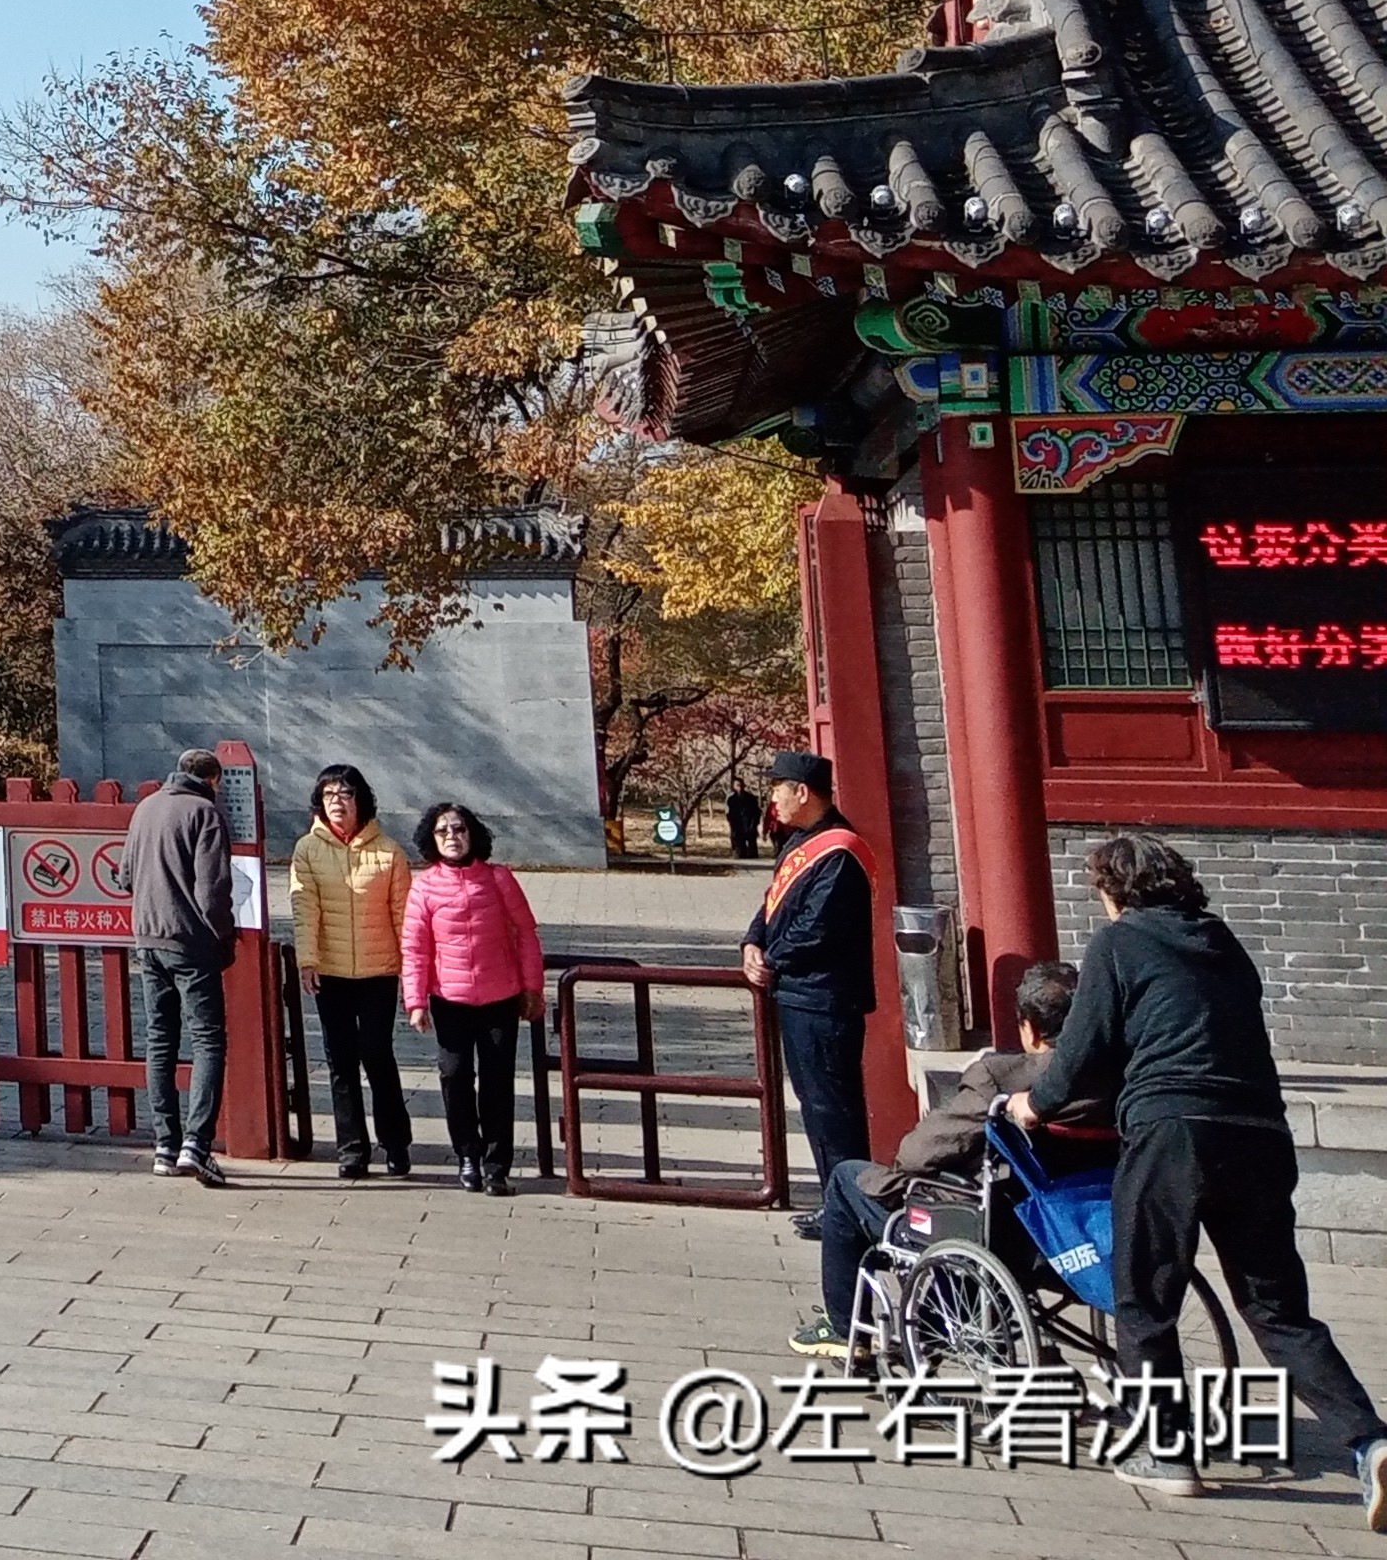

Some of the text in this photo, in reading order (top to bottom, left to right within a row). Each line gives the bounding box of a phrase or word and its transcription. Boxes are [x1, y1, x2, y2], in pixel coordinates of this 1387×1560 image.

[30, 907, 129, 930] 禁止带火种入
